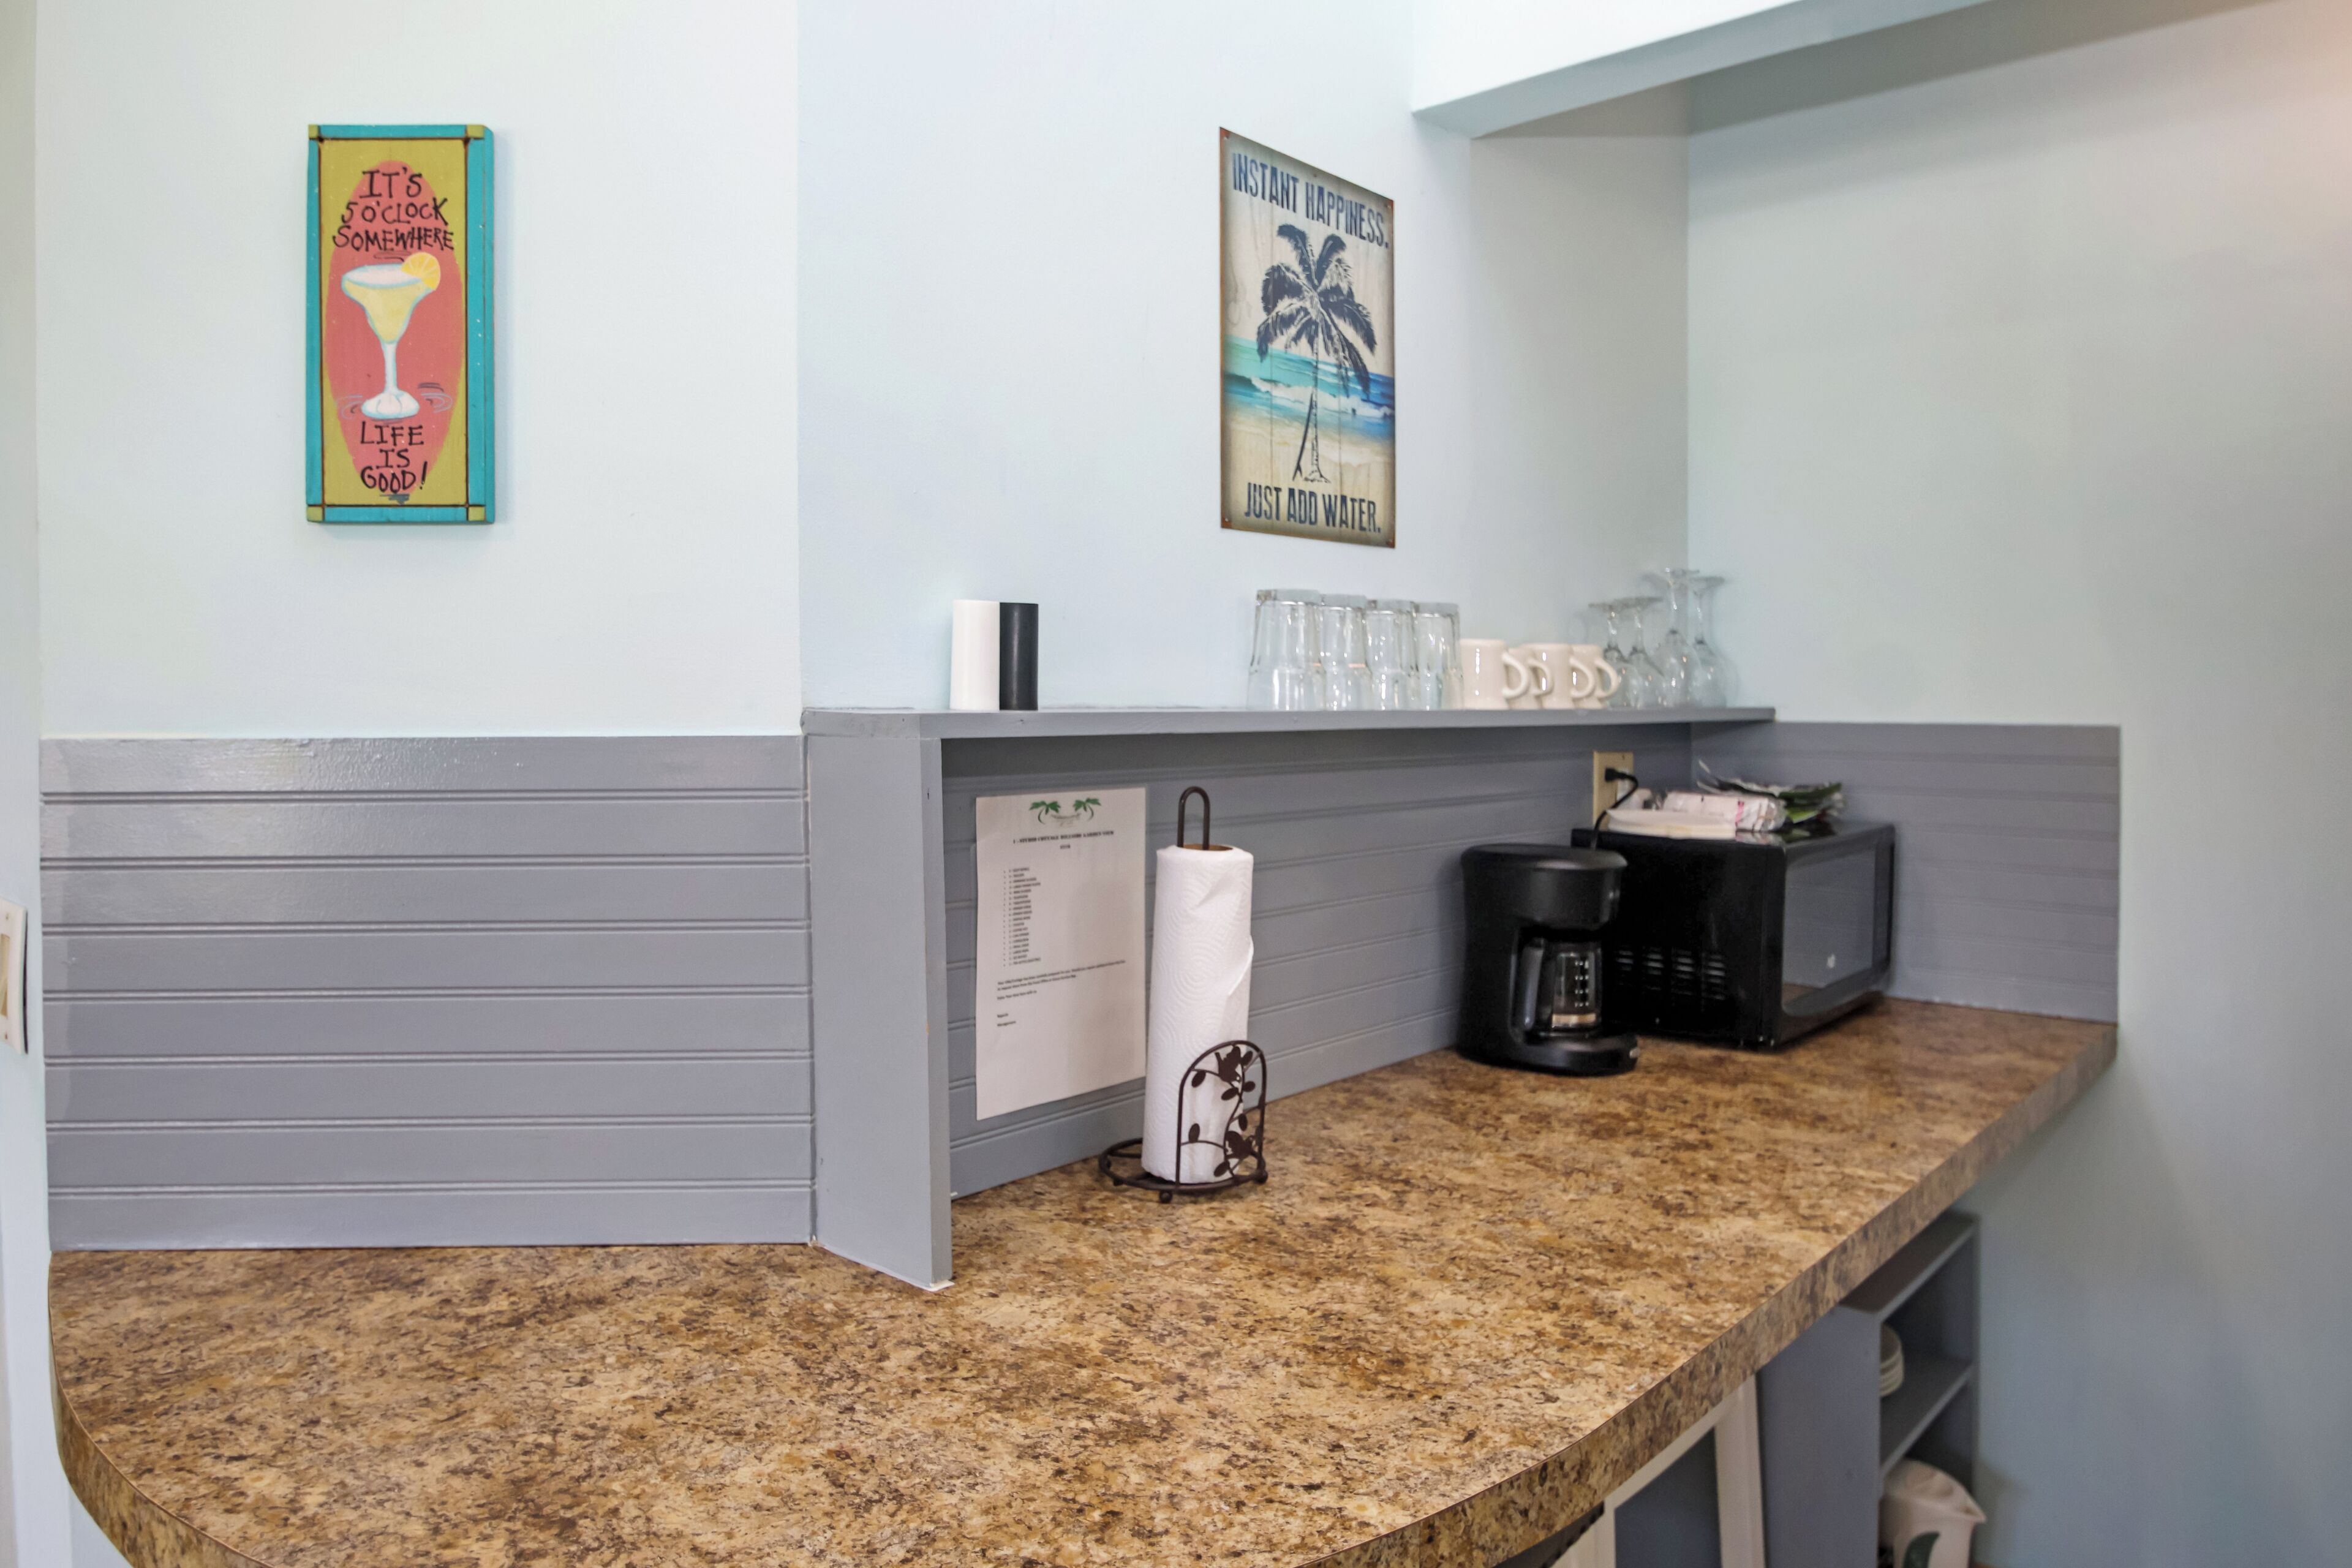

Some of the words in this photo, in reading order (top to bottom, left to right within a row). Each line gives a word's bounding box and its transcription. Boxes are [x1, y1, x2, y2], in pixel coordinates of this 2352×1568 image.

[359, 167, 423, 199] IT'S
[341, 202, 358, 224] 5
[361, 197, 448, 226] O'CLOCK
[1232, 153, 1299, 213] INSTANT
[1305, 181, 1390, 249] HAPPINESS.
[332, 225, 454, 252] SOMEWHERE
[360, 421, 424, 447] LIFE
[375, 448, 410, 469] IS
[360, 461, 428, 494] GOOD!
[1245, 482, 1281, 521] JUST
[1287, 488, 1317, 526] ADD
[1322, 494, 1381, 533] WATER.
